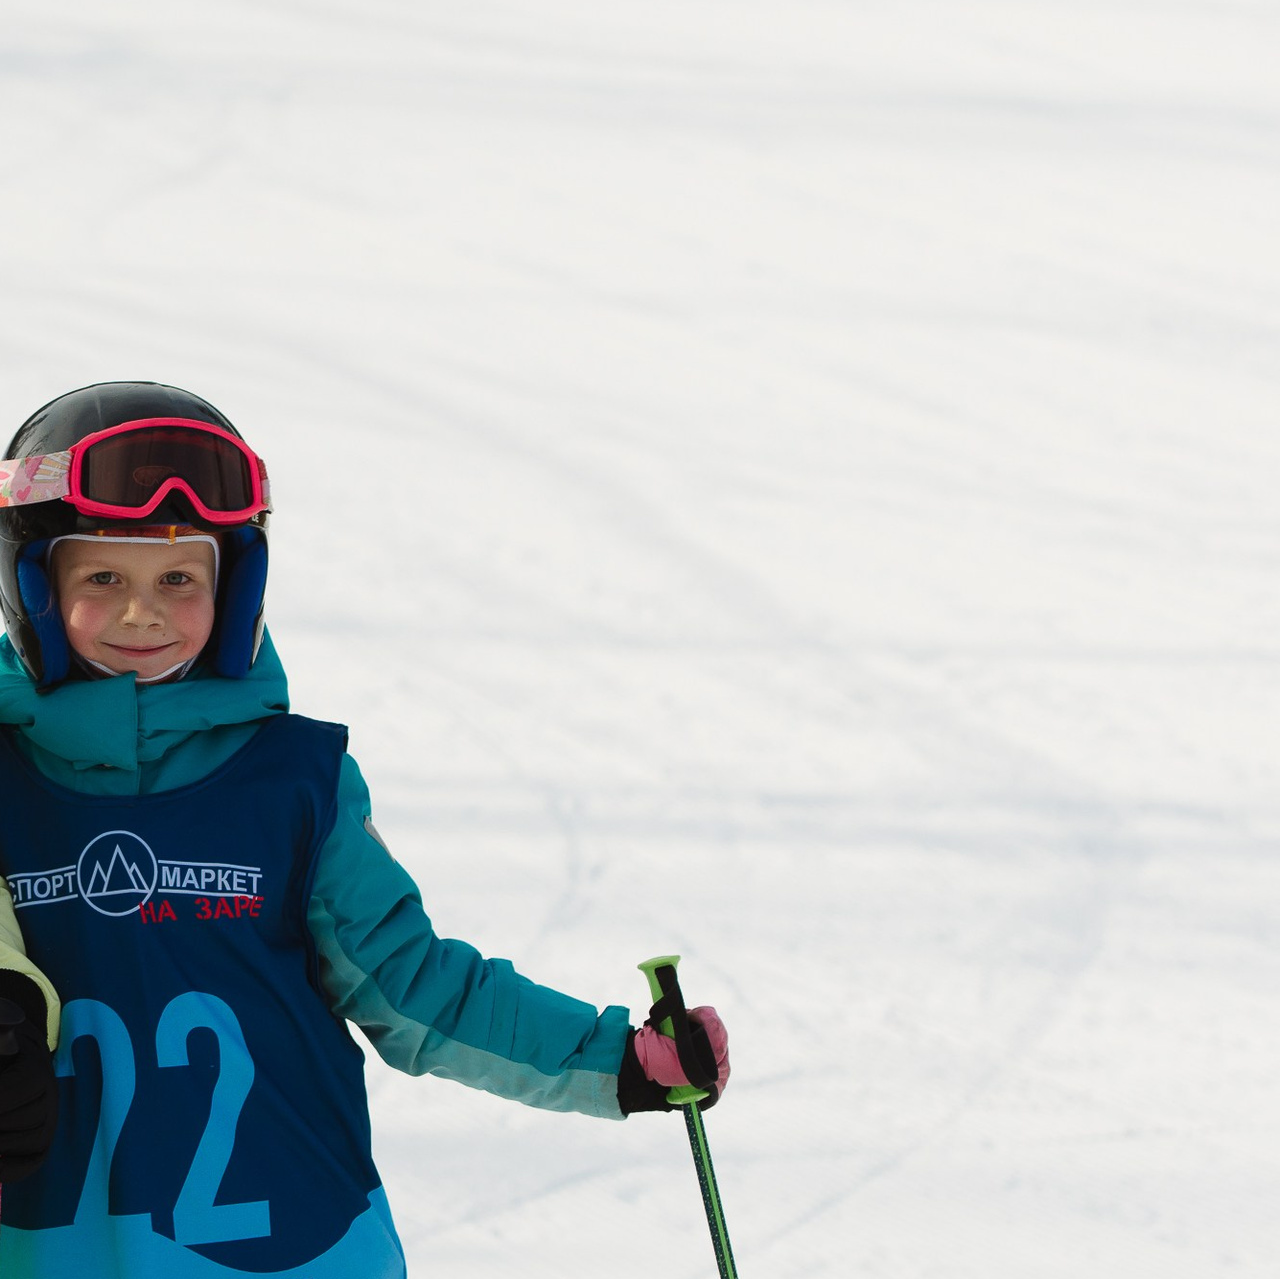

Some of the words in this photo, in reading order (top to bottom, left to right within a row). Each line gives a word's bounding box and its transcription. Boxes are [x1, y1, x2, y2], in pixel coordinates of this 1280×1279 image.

[161, 865, 263, 894] МАРКЕТ
[138, 899, 178, 925] НА
[195, 895, 265, 921] ЗАРЕ
[56, 991, 271, 1246] 22
